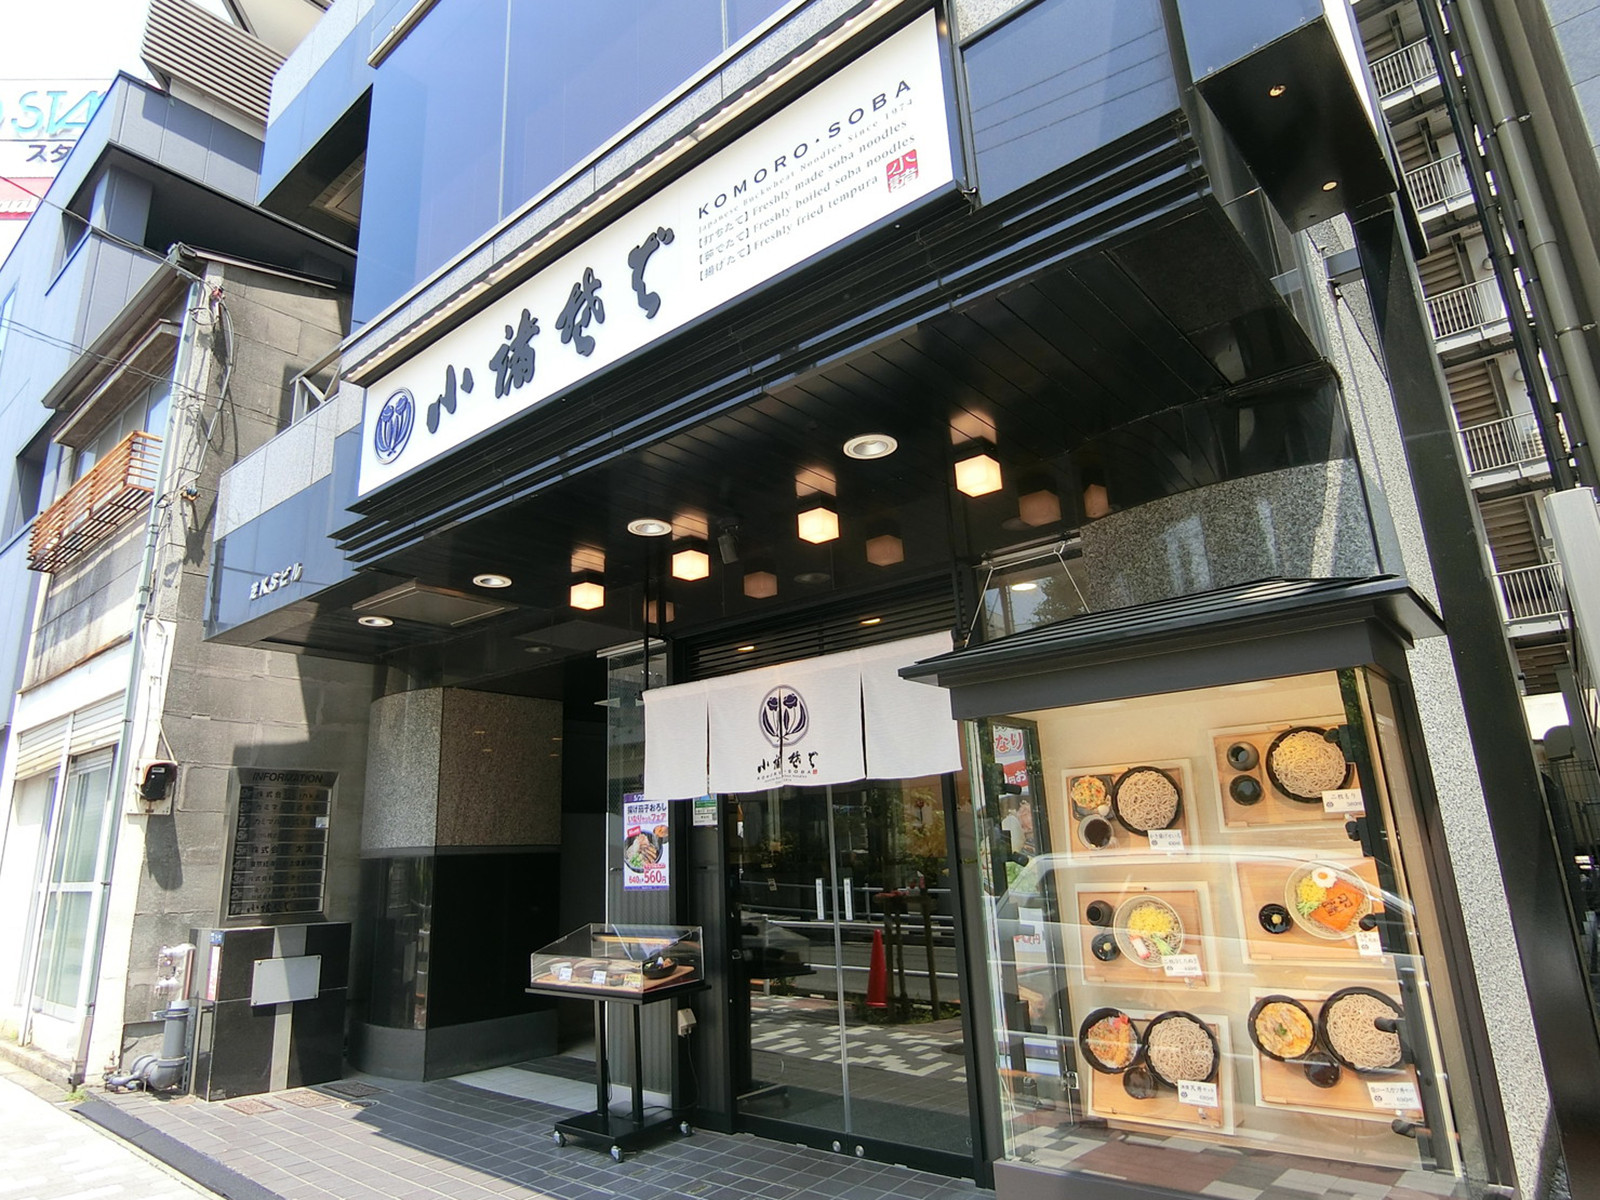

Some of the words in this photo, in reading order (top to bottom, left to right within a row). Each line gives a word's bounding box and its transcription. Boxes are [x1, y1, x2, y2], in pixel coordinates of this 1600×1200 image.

[698, 204, 739, 232] Japanese
[743, 171, 795, 206] Buckwheat
[800, 142, 843, 172] Noodles
[847, 120, 879, 143] Since
[884, 98, 914, 119] 1974
[753, 189, 791, 217] Freshly
[794, 168, 825, 192] made
[828, 152, 855, 171] soba
[859, 120, 908, 154] noodles
[753, 206, 792, 235] Freshly
[795, 183, 831, 208] boiled
[834, 166, 862, 186] soba
[866, 134, 916, 168] noodles
[754, 221, 793, 251] Freshly
[796, 205, 825, 227] fried
[828, 174, 879, 210] tempura
[252, 772, 323, 783] INFORMATION
